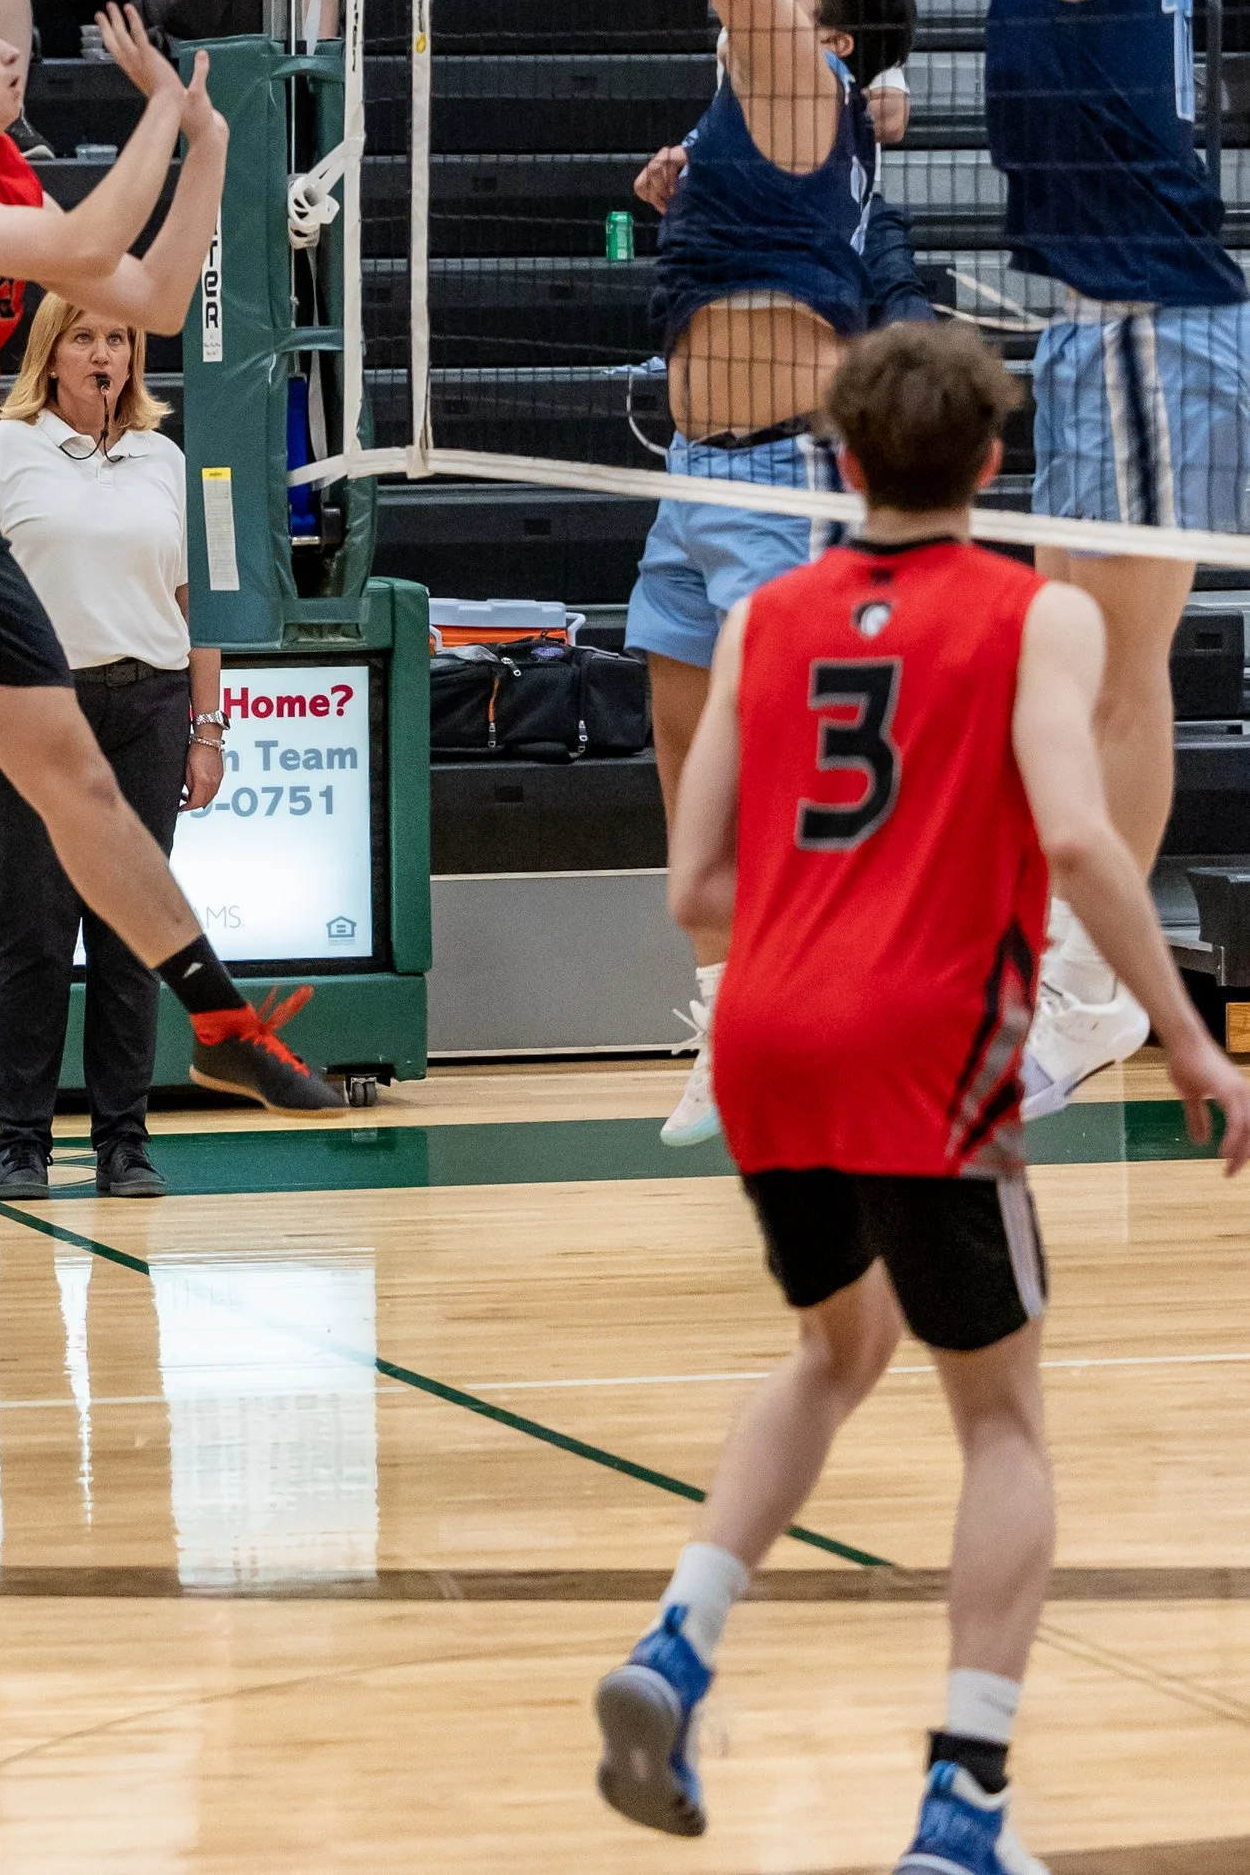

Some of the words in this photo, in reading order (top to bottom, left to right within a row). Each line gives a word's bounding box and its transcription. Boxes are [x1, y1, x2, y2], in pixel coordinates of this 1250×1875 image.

[223, 684, 354, 719] Home?
[254, 740, 358, 772] Team
[795, 656, 903, 852] 3
